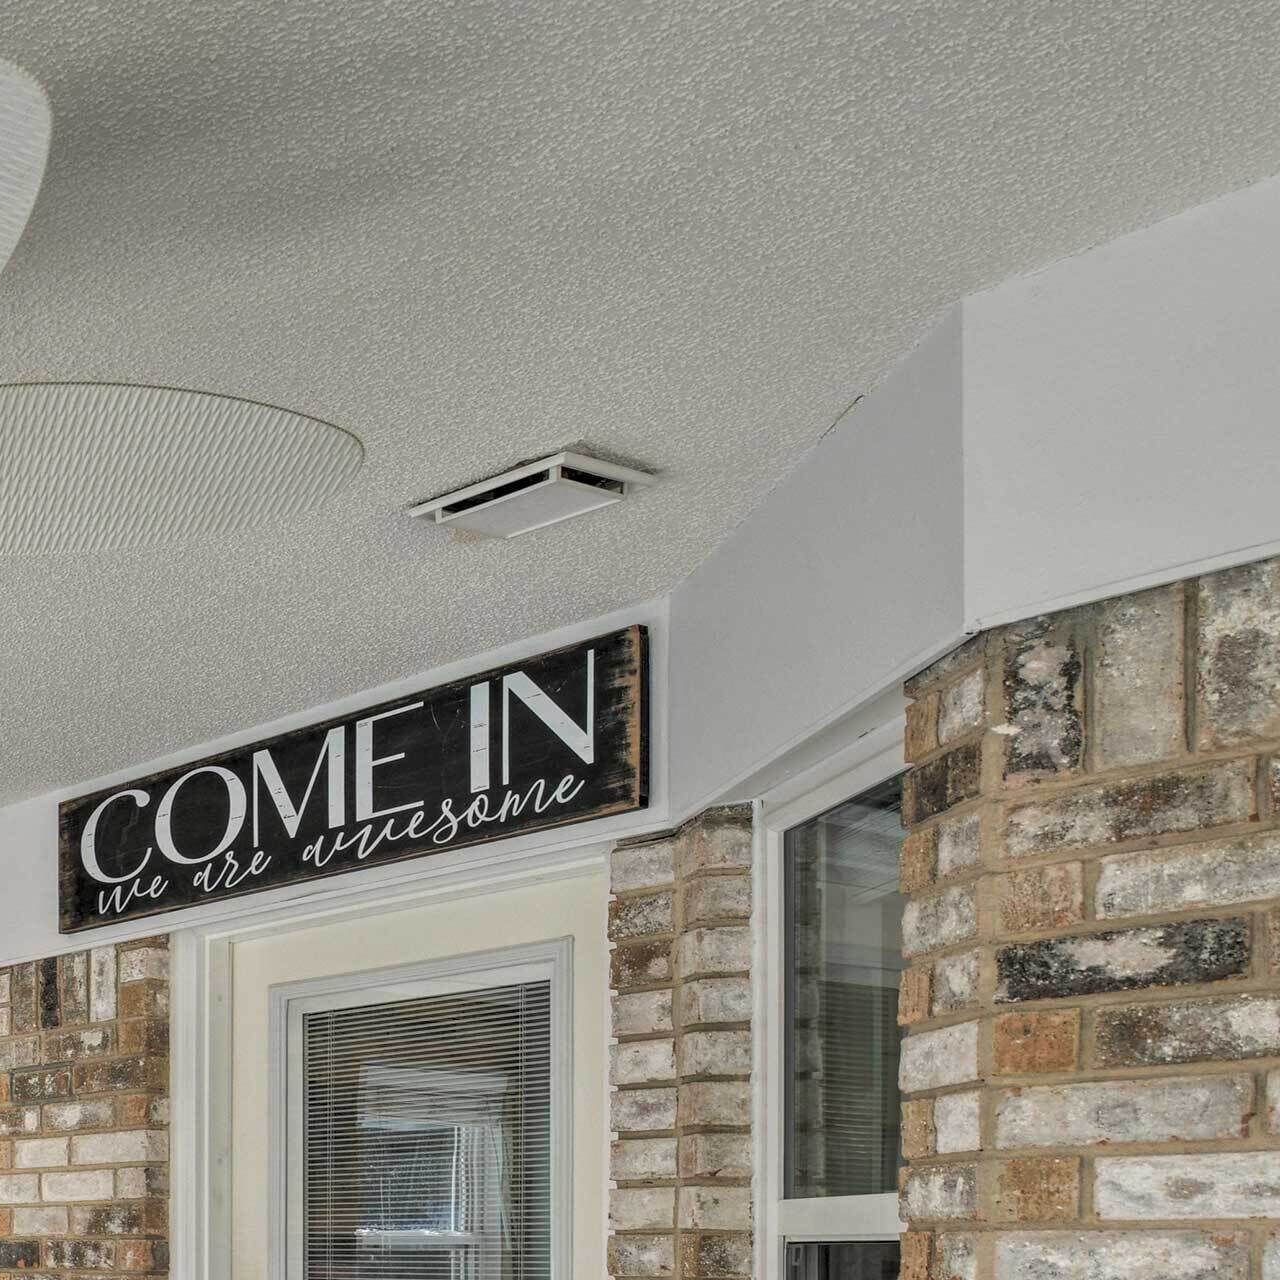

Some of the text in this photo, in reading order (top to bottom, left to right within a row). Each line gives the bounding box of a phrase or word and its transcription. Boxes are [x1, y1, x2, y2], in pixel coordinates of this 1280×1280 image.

[80, 649, 595, 884] COME IN
[98, 772, 585, 915] we are awesome
